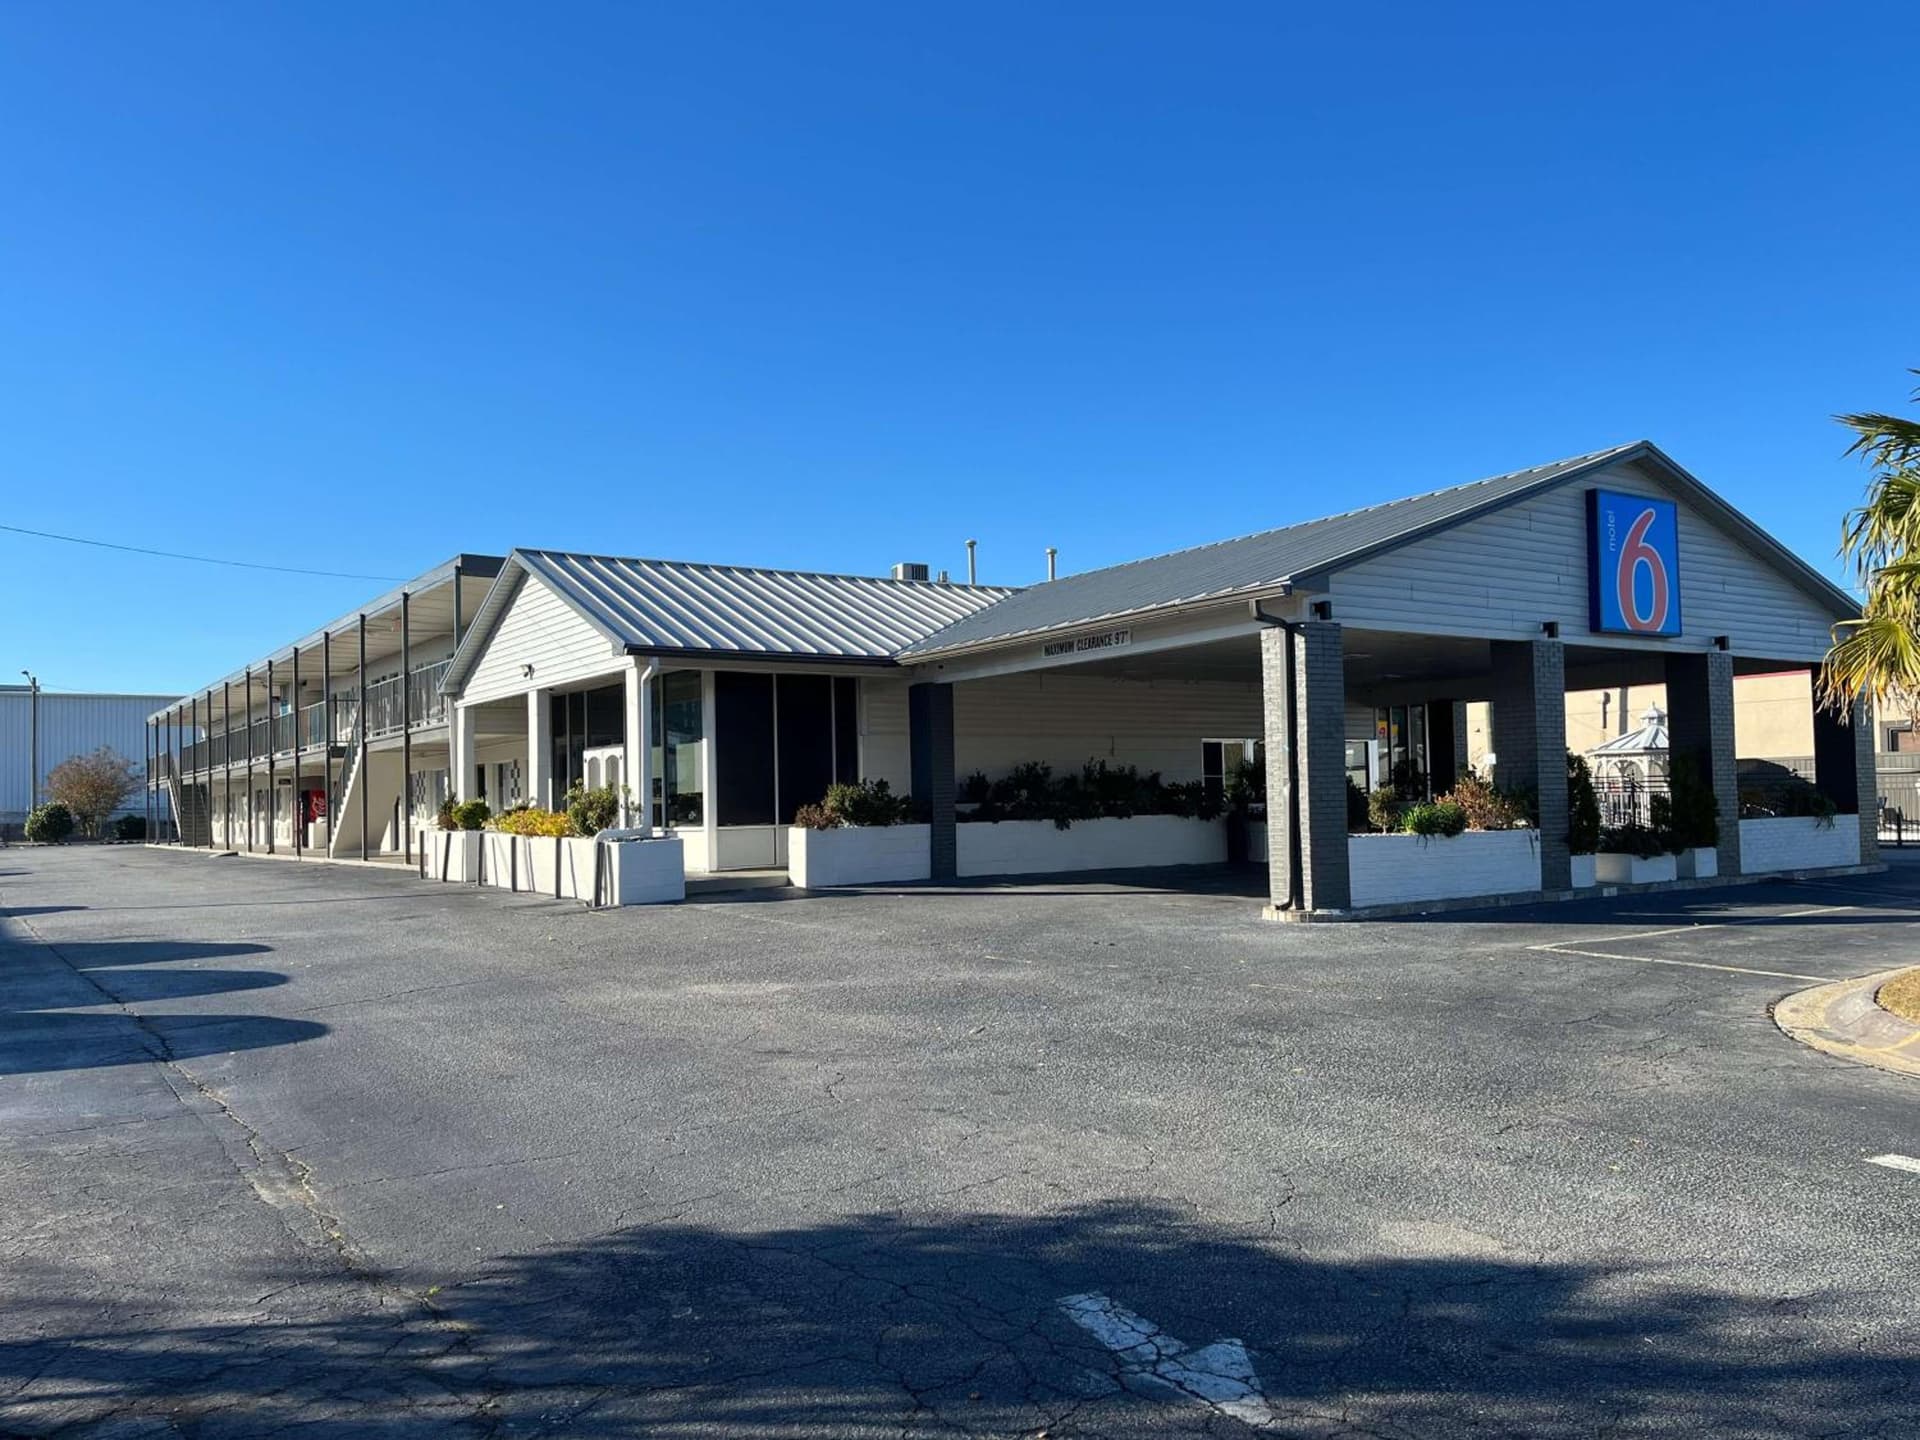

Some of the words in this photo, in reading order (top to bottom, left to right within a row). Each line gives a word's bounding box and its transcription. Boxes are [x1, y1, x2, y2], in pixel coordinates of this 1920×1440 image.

[1606, 510, 1616, 552] motel
[1616, 508, 1669, 632] 6
[1044, 640, 1075, 656] MAXIMUM
[1077, 633, 1113, 651] CLEARANCE
